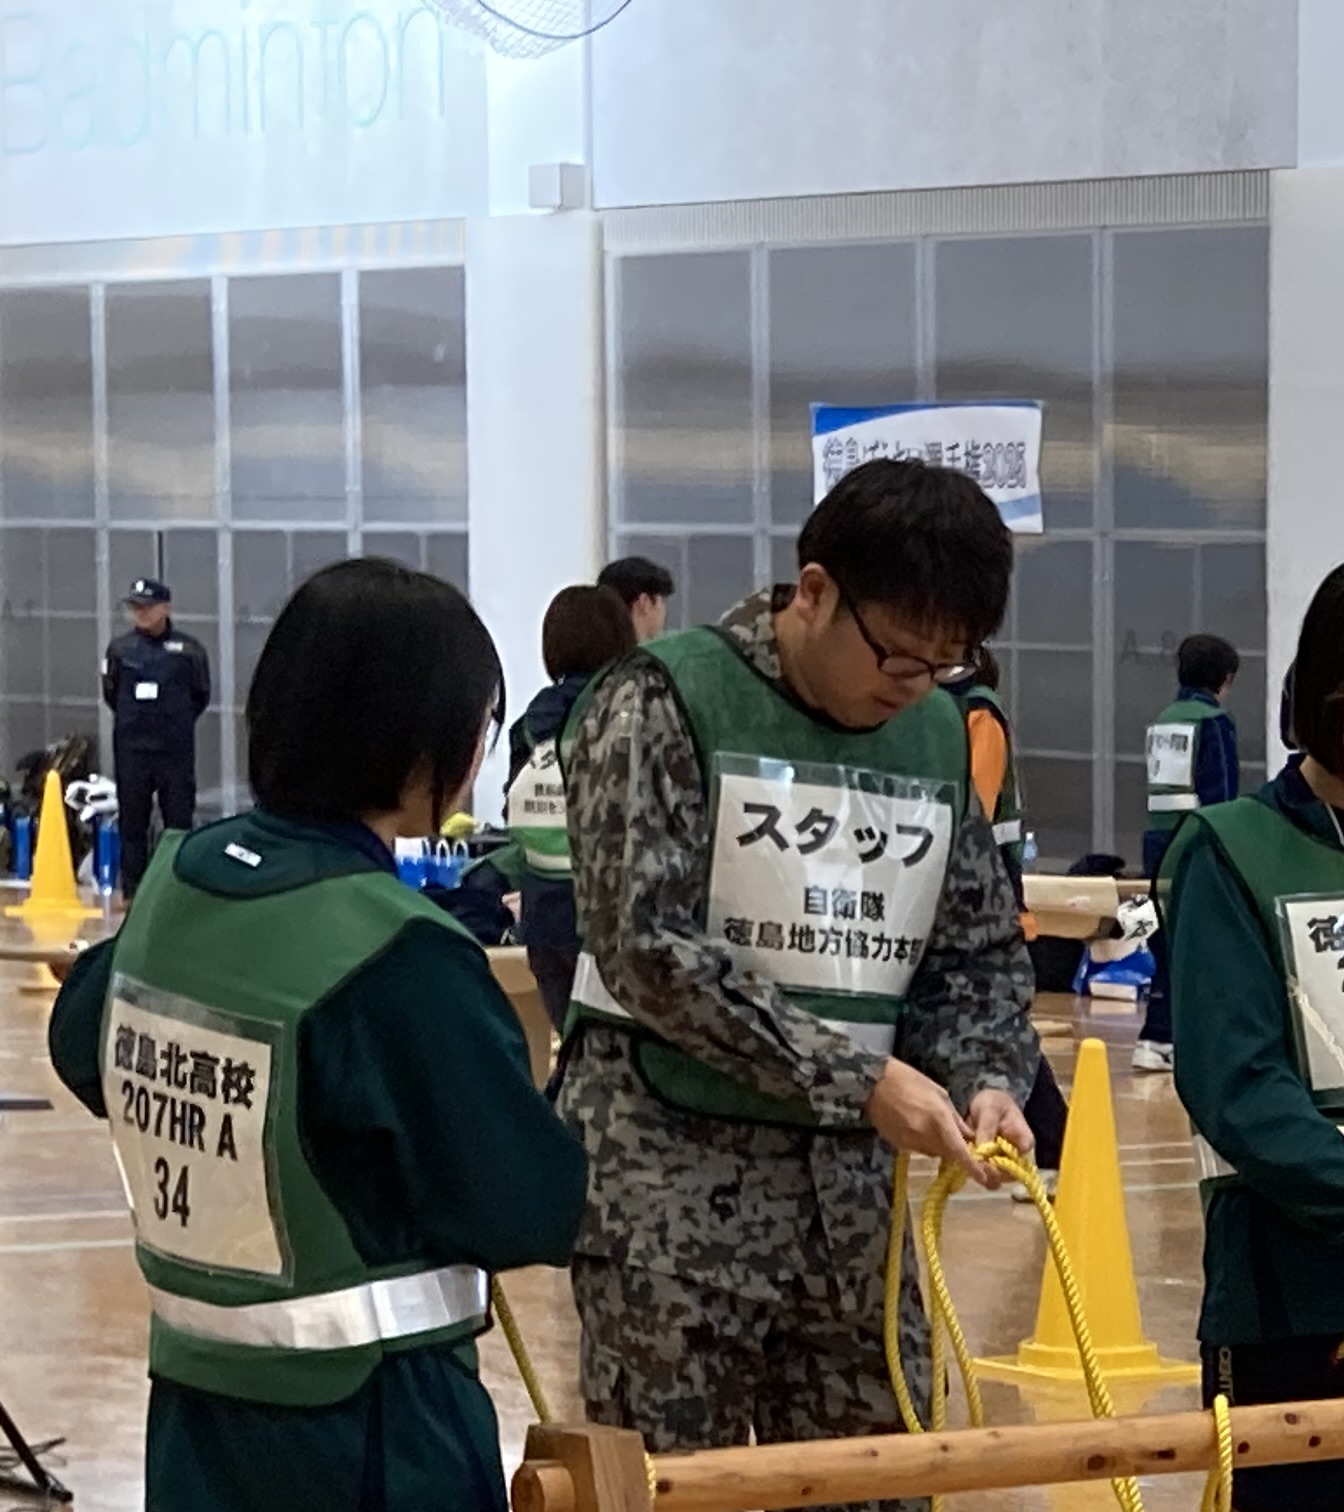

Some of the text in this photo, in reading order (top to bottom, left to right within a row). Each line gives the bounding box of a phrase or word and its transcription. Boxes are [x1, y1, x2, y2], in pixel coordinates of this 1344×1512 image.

[736, 802, 935, 868] スタッフ
[803, 886, 886, 922] 自衛隊
[114, 1023, 257, 1110] 徳島北高校
[121, 1080, 238, 1162] 207HR A
[153, 1157, 191, 1228] 34
